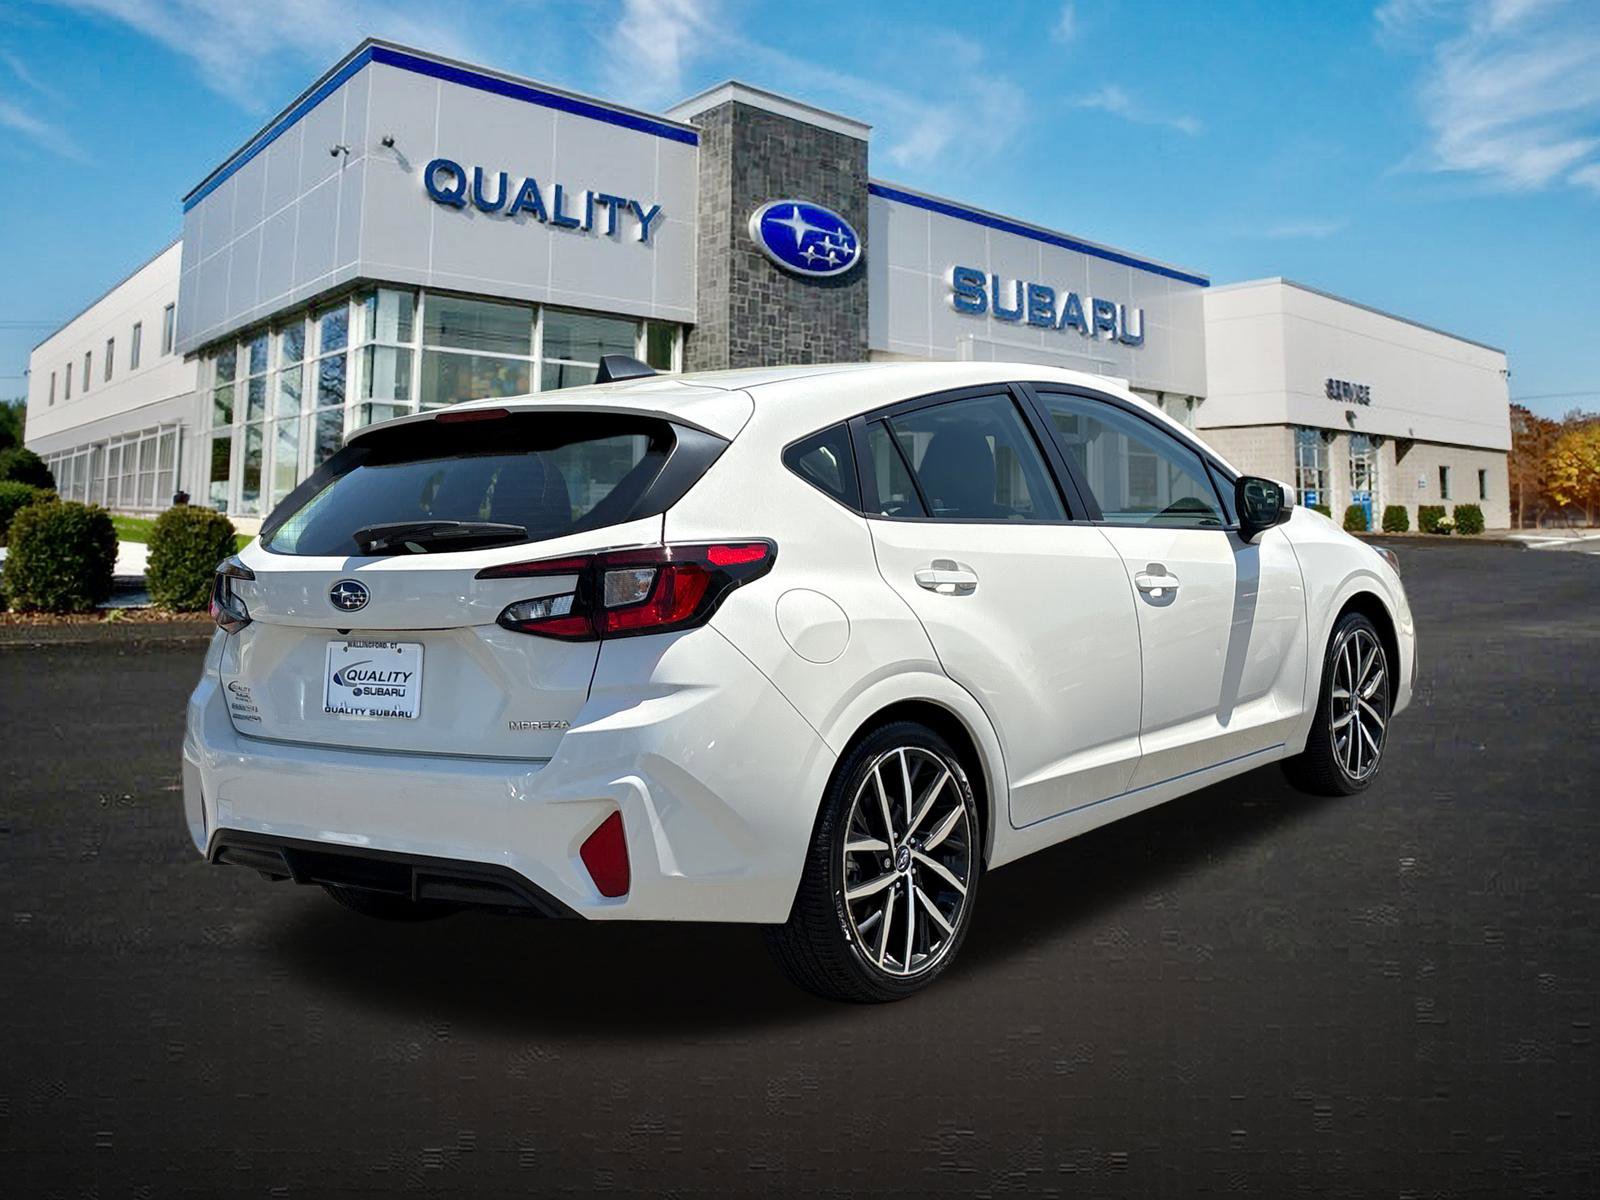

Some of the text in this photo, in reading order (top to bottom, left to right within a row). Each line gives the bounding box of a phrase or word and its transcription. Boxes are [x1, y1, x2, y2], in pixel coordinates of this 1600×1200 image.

[424, 158, 662, 243] QUALITY
[950, 265, 1145, 347] SUBARU
[346, 669, 413, 683] QUALITY
[363, 686, 406, 698] SUBARU
[324, 706, 413, 719] QUALITY SUBARU
